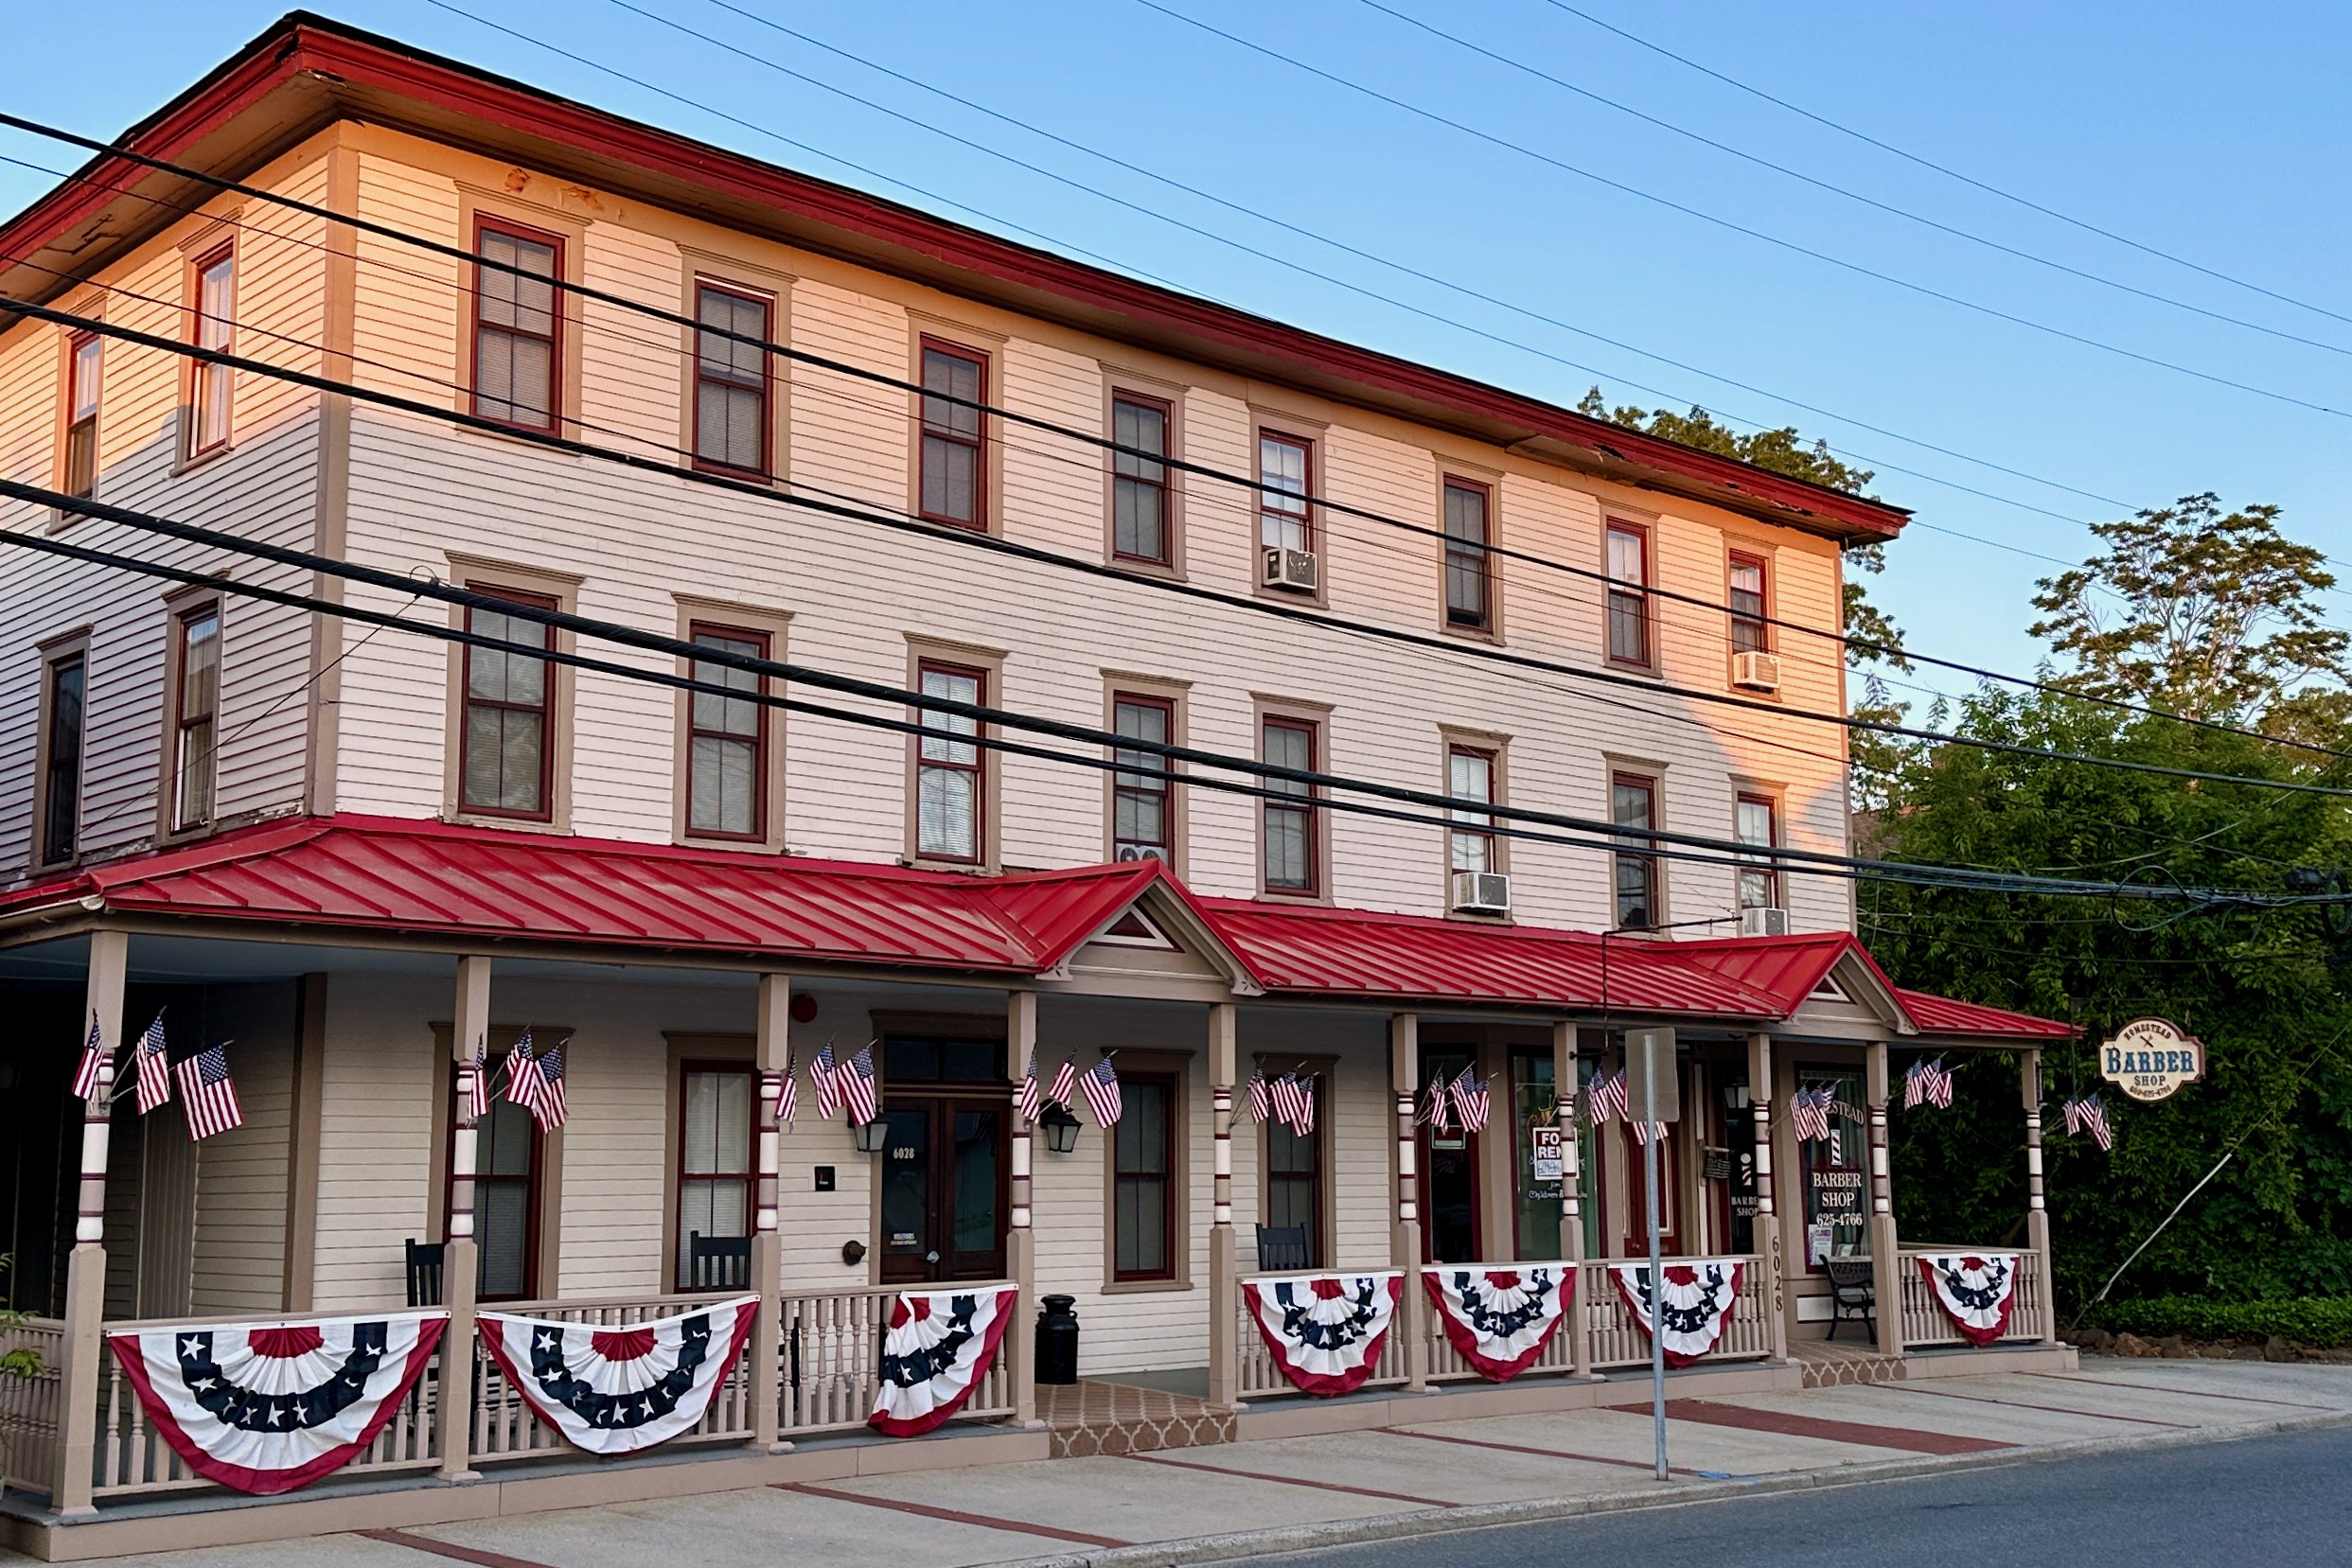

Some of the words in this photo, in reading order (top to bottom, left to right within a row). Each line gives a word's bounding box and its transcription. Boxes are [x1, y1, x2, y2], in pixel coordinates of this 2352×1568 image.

[2123, 1023, 2172, 1041] HOMESTEAD
[2105, 1047, 2195, 1074] BARBER
[2134, 1075, 2166, 1086] SHOP
[1541, 1132, 1561, 1145] FO
[893, 1147, 915, 1159] 6028
[1537, 1145, 1562, 1159] REN
[1812, 1172, 1863, 1188] BARBER
[1731, 1196, 1760, 1207] BARBE
[1821, 1191, 1855, 1207] SHOP
[1816, 1212, 1864, 1226] 625-4766
[1772, 1236, 1783, 1313] 6028
